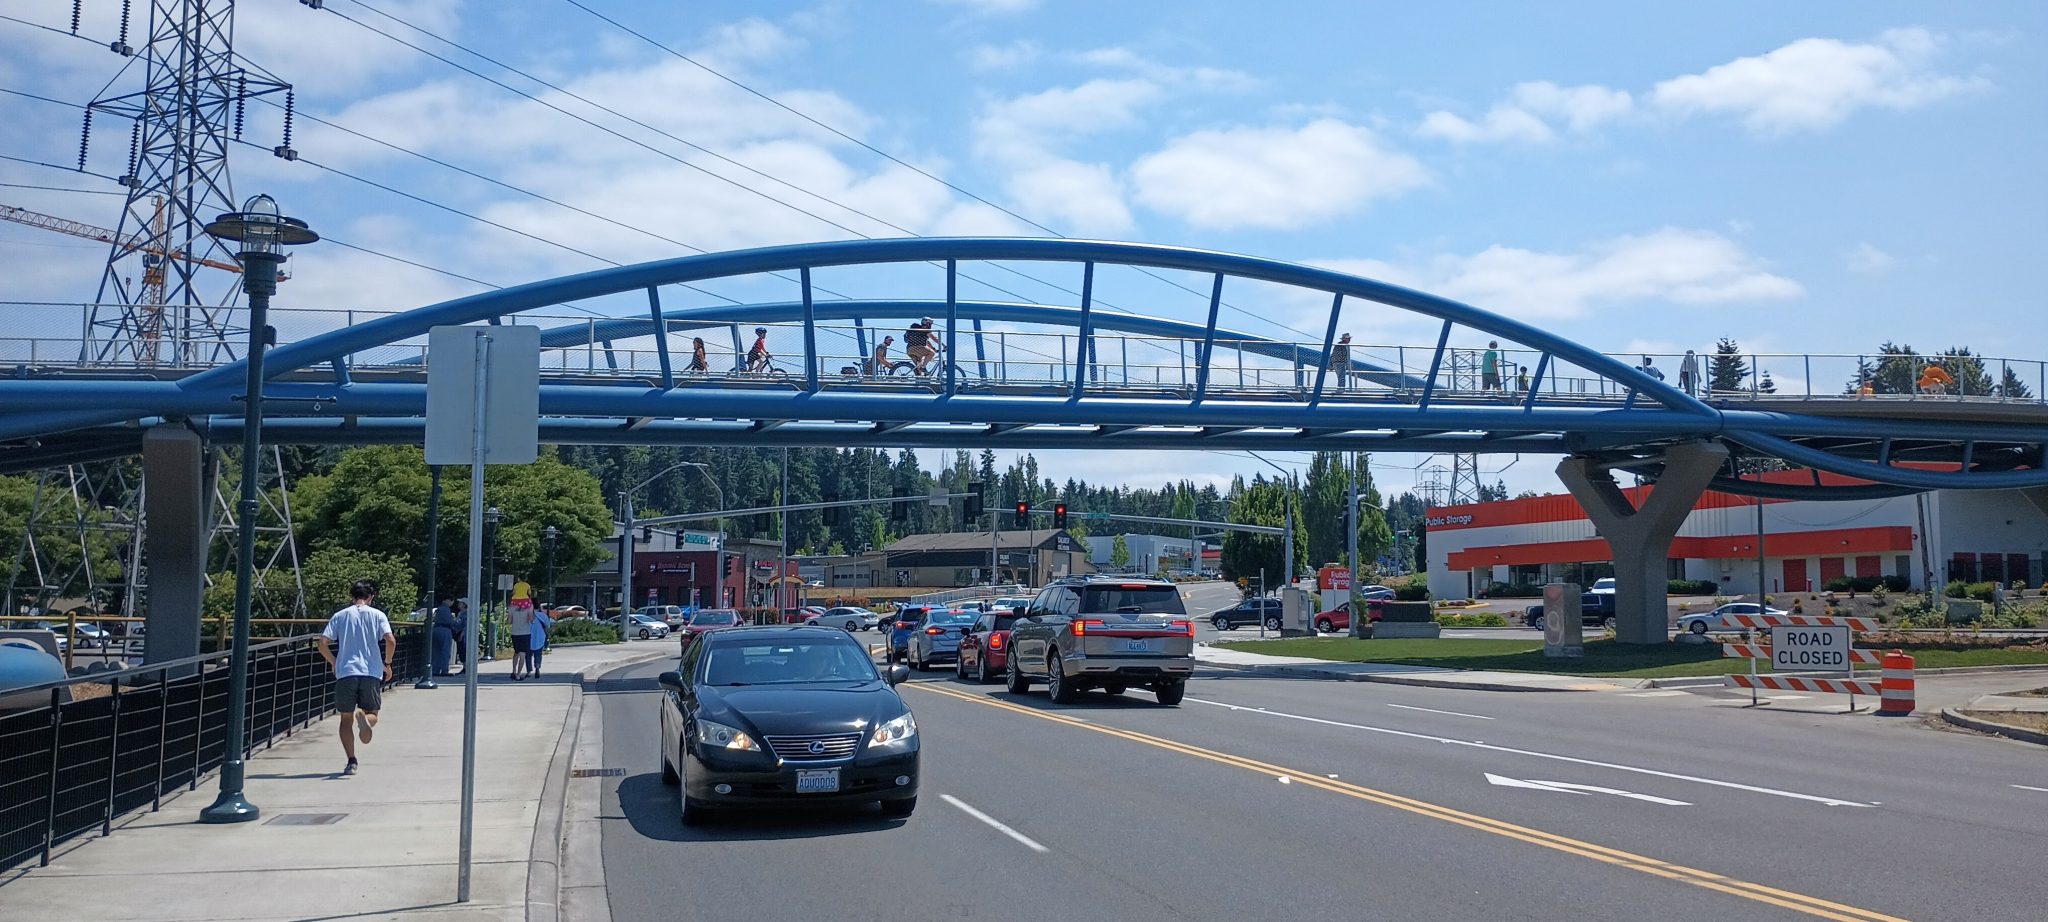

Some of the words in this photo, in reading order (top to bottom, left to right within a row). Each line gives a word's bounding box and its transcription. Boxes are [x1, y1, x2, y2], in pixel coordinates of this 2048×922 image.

[1425, 517, 1445, 526] Public
[1446, 514, 1472, 525] Storage
[1328, 578, 1350, 587] Storag
[1787, 632, 1833, 645] ROAD
[1778, 651, 1842, 665] CLOSED
